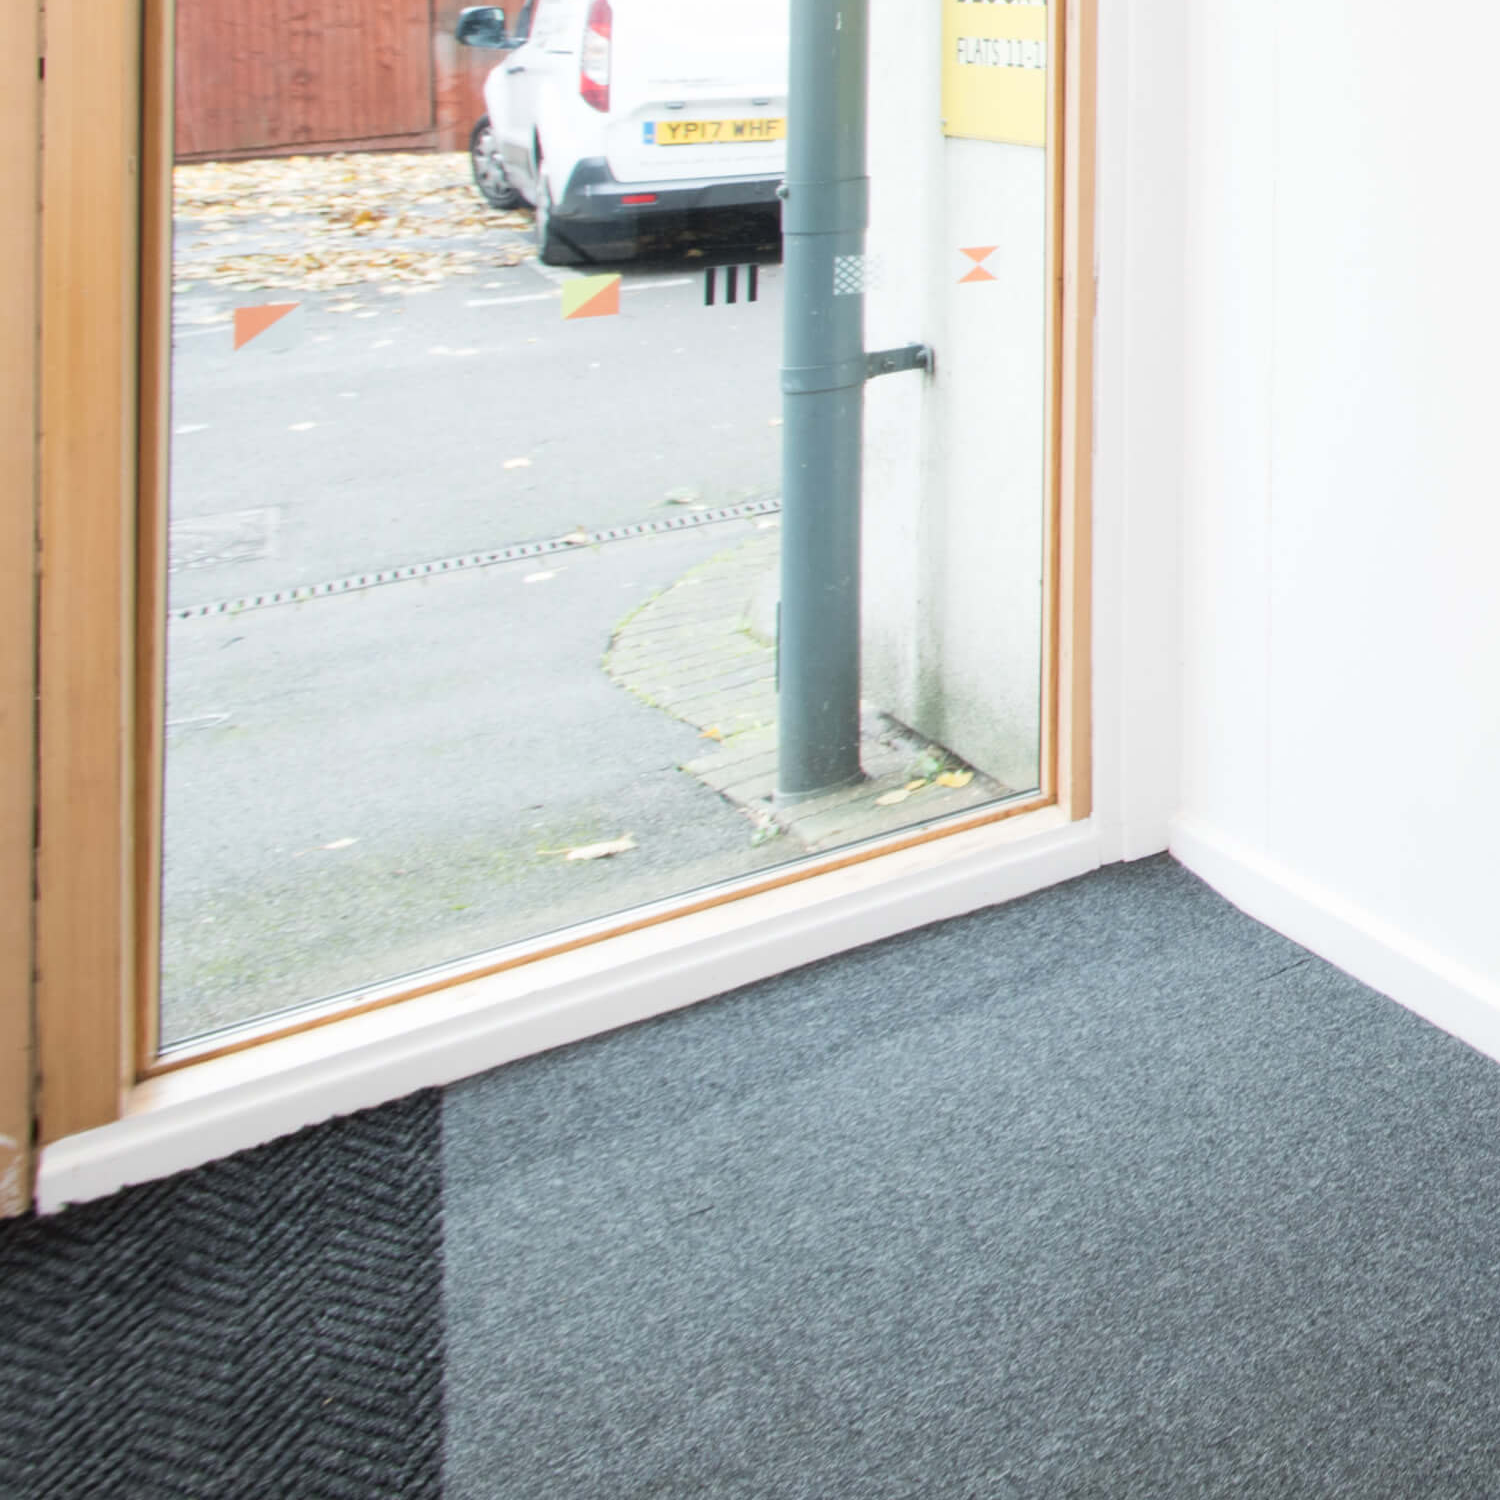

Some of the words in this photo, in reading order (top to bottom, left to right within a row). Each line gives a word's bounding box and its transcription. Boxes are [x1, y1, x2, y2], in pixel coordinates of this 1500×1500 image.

[957, 36, 999, 67] FLATS
[1006, 39, 1048, 70] 11-1
[666, 121, 723, 140] YP17
[733, 119, 781, 137] WHF
